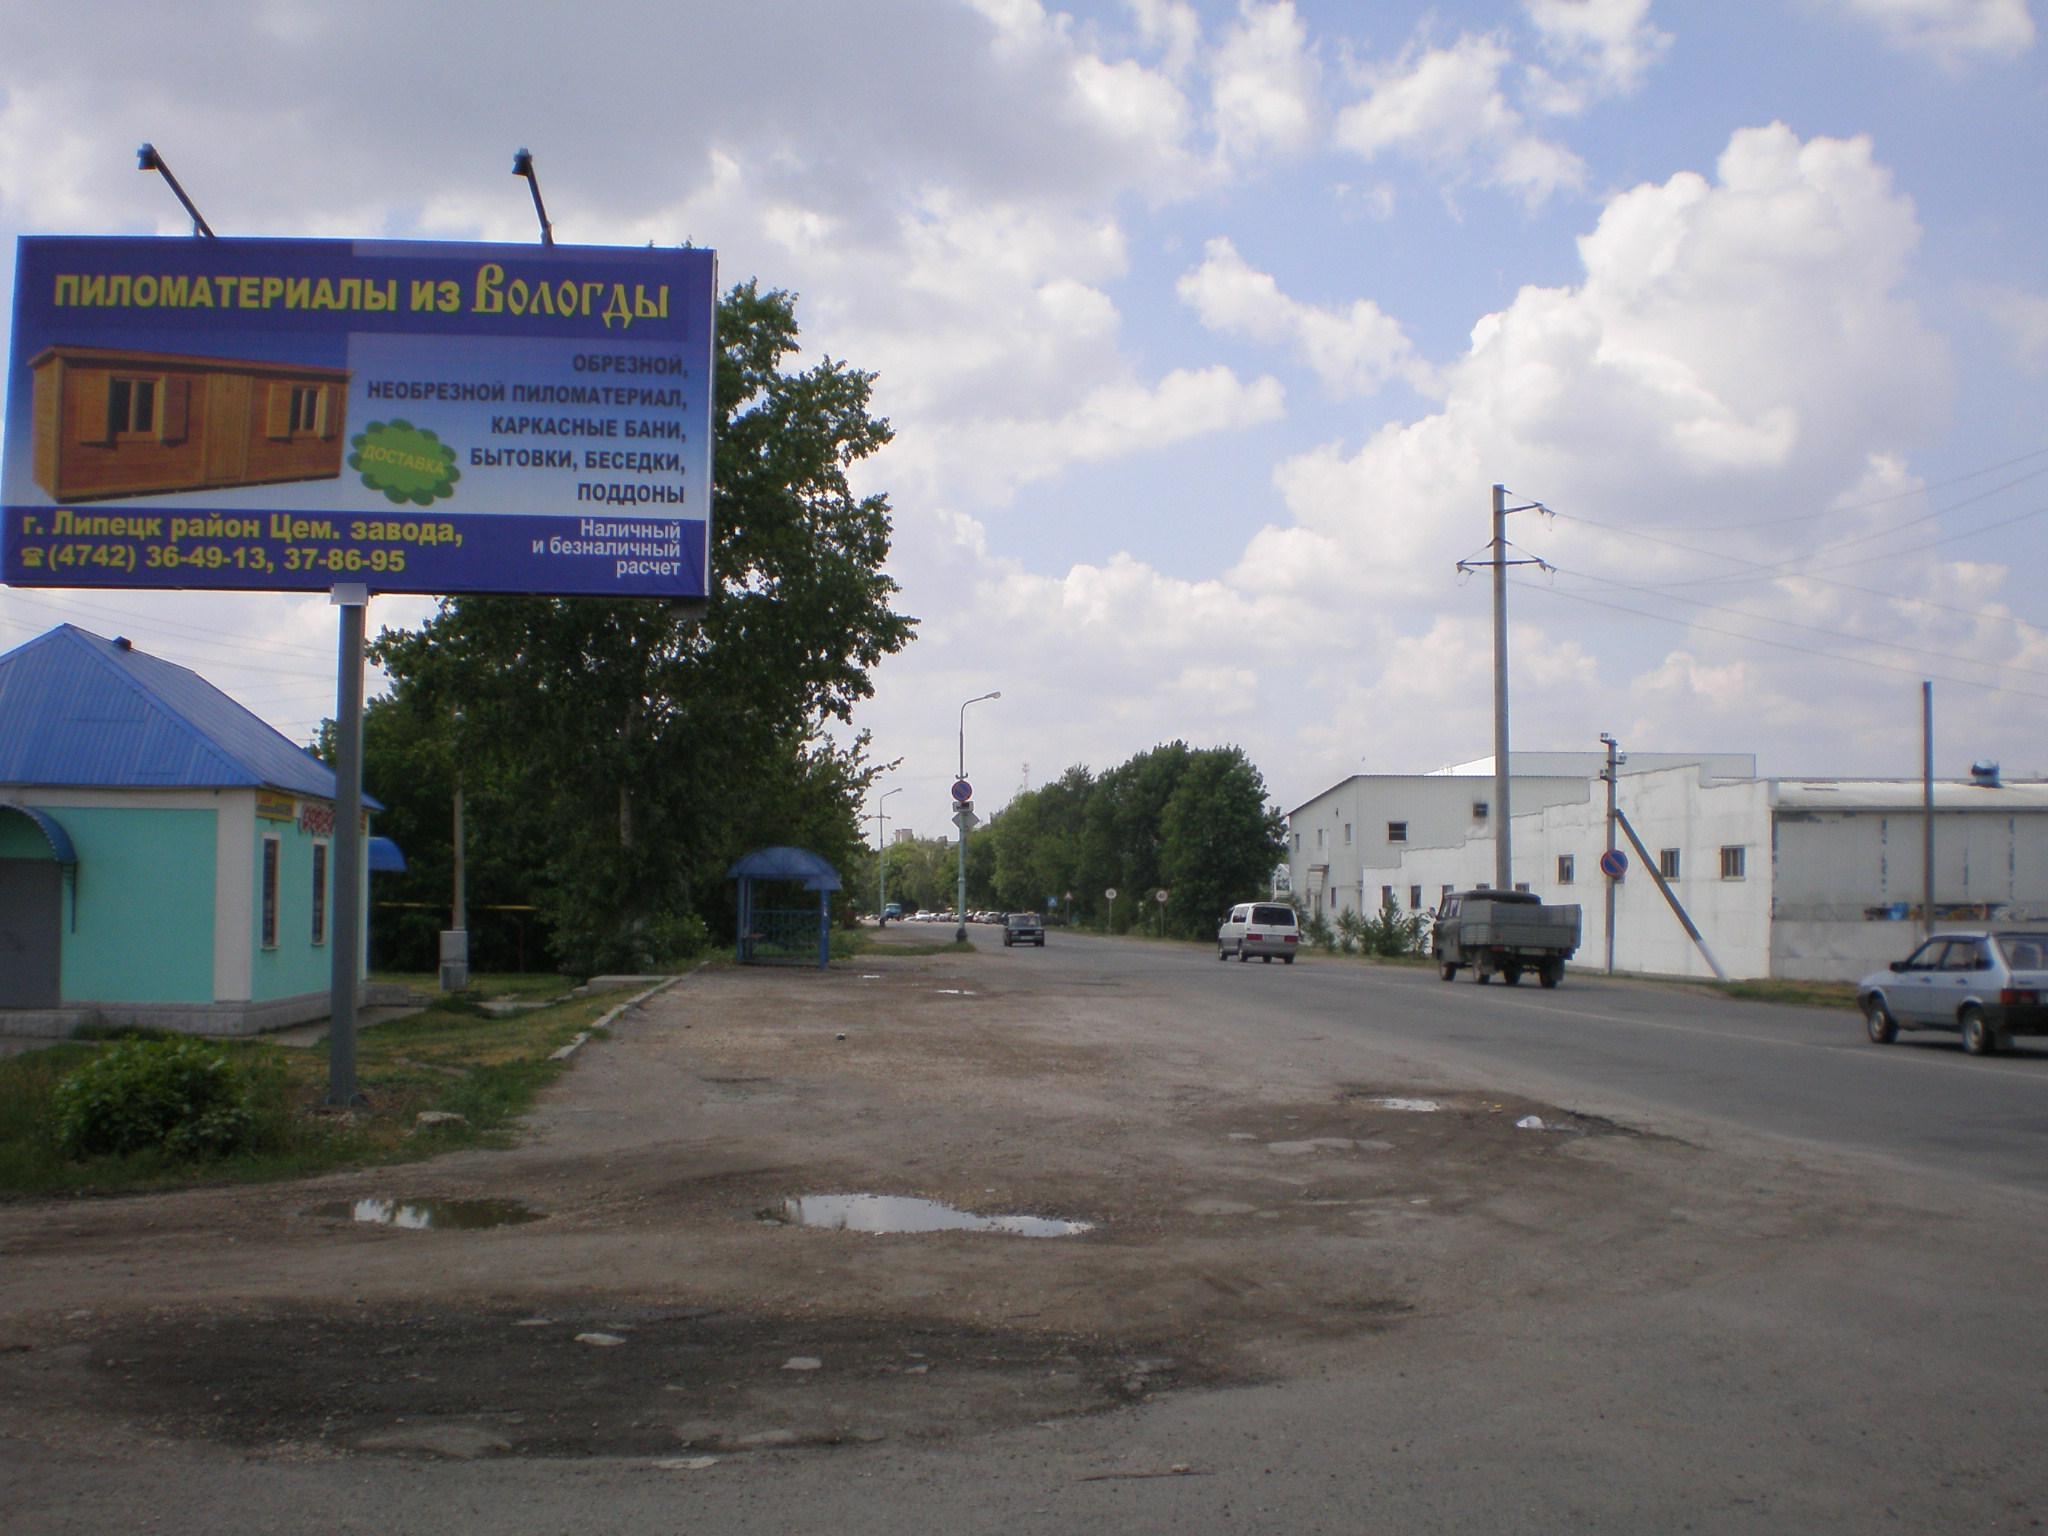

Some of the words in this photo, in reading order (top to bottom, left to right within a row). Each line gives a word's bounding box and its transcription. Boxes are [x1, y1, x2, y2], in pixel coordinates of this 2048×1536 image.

[54, 274, 397, 311] ПИЛОМАТЕРИАЛЫ
[573, 352, 688, 379] ОБРЕЗНОЙ,
[367, 378, 505, 402] НЕОБРЕЗНОЙ
[512, 384, 687, 410] ПИЛОМАТЕРИАЛ,
[491, 416, 618, 438] КАРКАСНЫЕ
[624, 420, 687, 443] БАНИ,
[361, 444, 445, 476] ДОСТАВКА
[470, 448, 578, 472] БЫТОВКИ,
[585, 450, 686, 475] БЕСЕДКИ,
[577, 482, 685, 506] ПОДДОНЫ
[23, 514, 43, 536] г.
[52, 511, 161, 542] Липецк
[170, 513, 260, 541] район
[270, 514, 340, 543] Цем.
[350, 520, 463, 548] завода,
[580, 519, 681, 539] Наличный
[48, 544, 136, 572] (4742)
[146, 546, 275, 574] 36-49-13,
[284, 549, 405, 572] 37-86-95
[532, 540, 545, 555] и
[550, 537, 681, 558] безналичный
[616, 560, 680, 578] расчет
